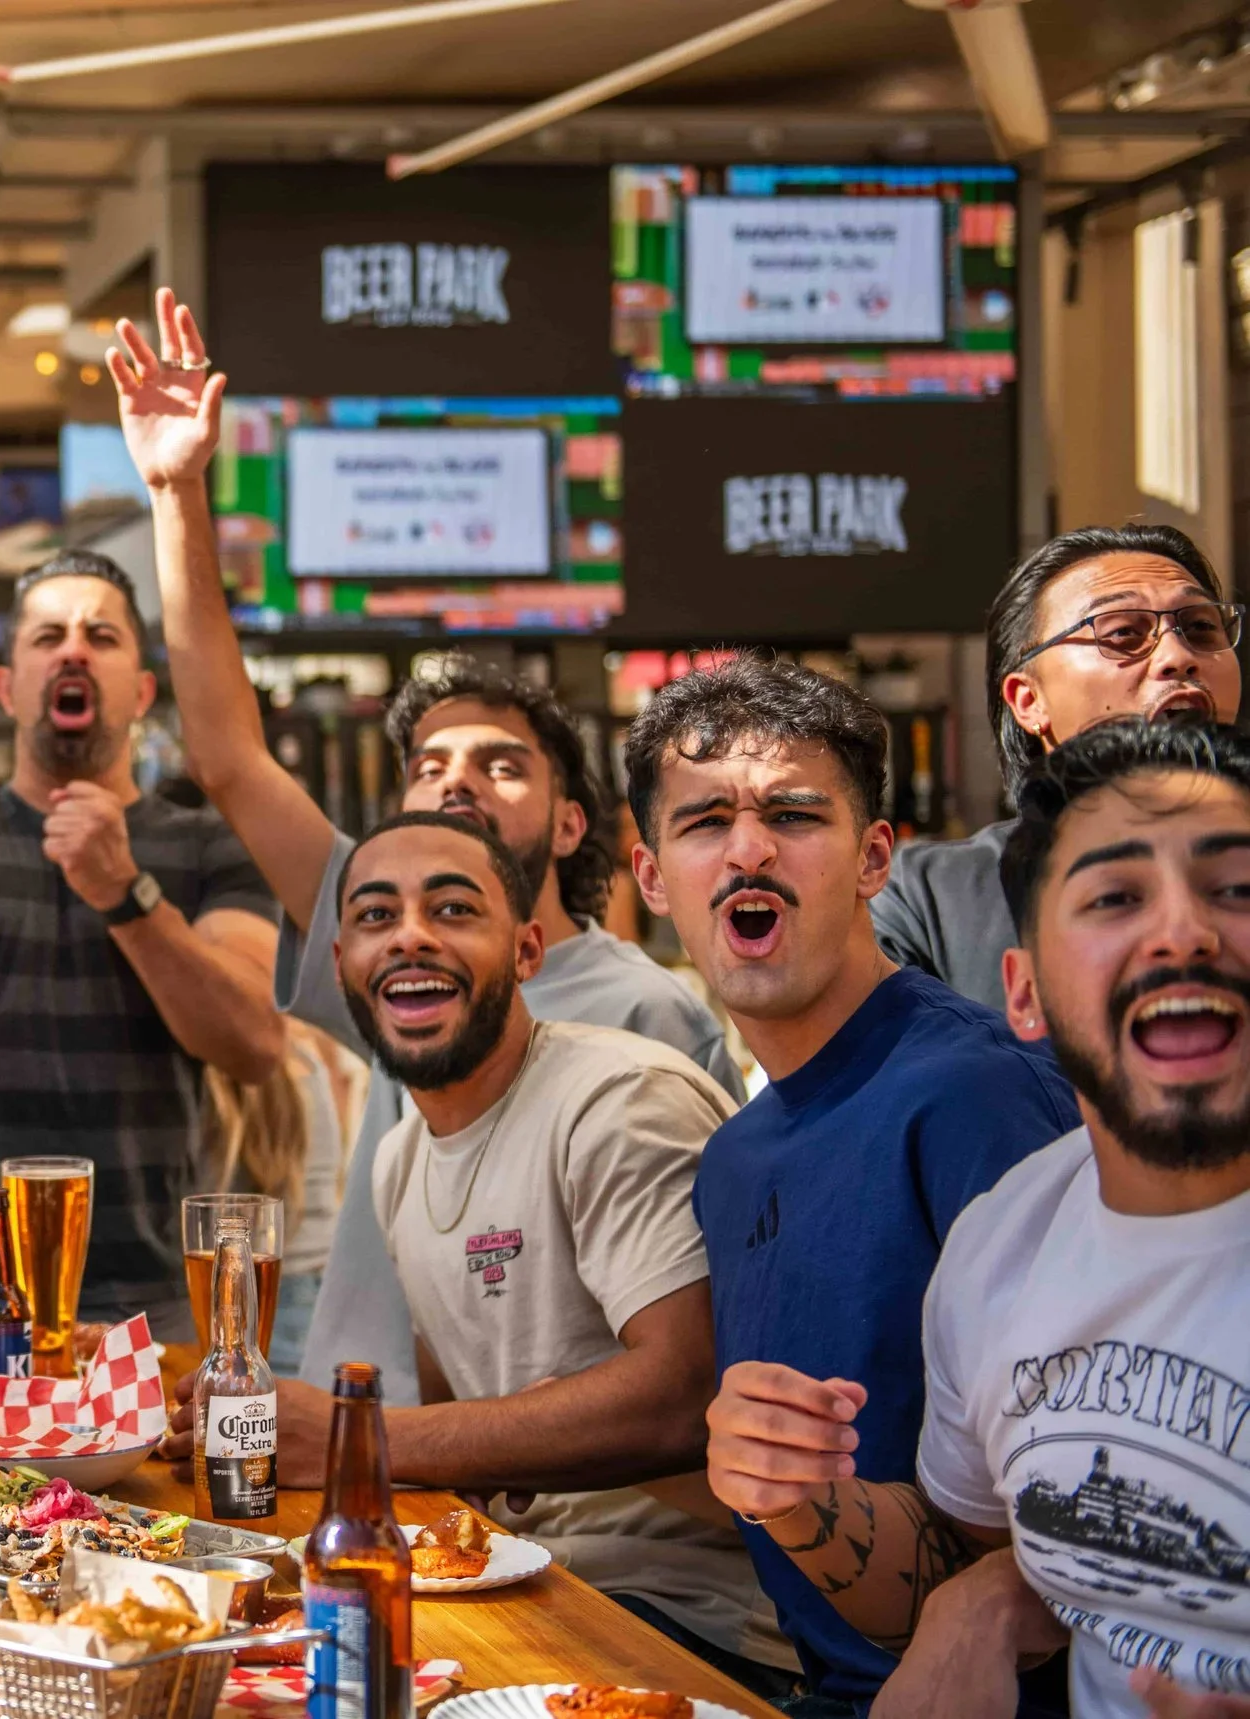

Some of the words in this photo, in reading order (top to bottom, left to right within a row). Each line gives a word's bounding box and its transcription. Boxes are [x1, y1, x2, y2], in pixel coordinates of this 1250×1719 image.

[321, 243, 413, 324] BEER
[416, 241, 510, 324] PARK
[724, 473, 812, 554] BEER
[816, 472, 909, 554] PARK
[218, 1415, 276, 1442] Coron
[240, 1436, 272, 1451] Extra
